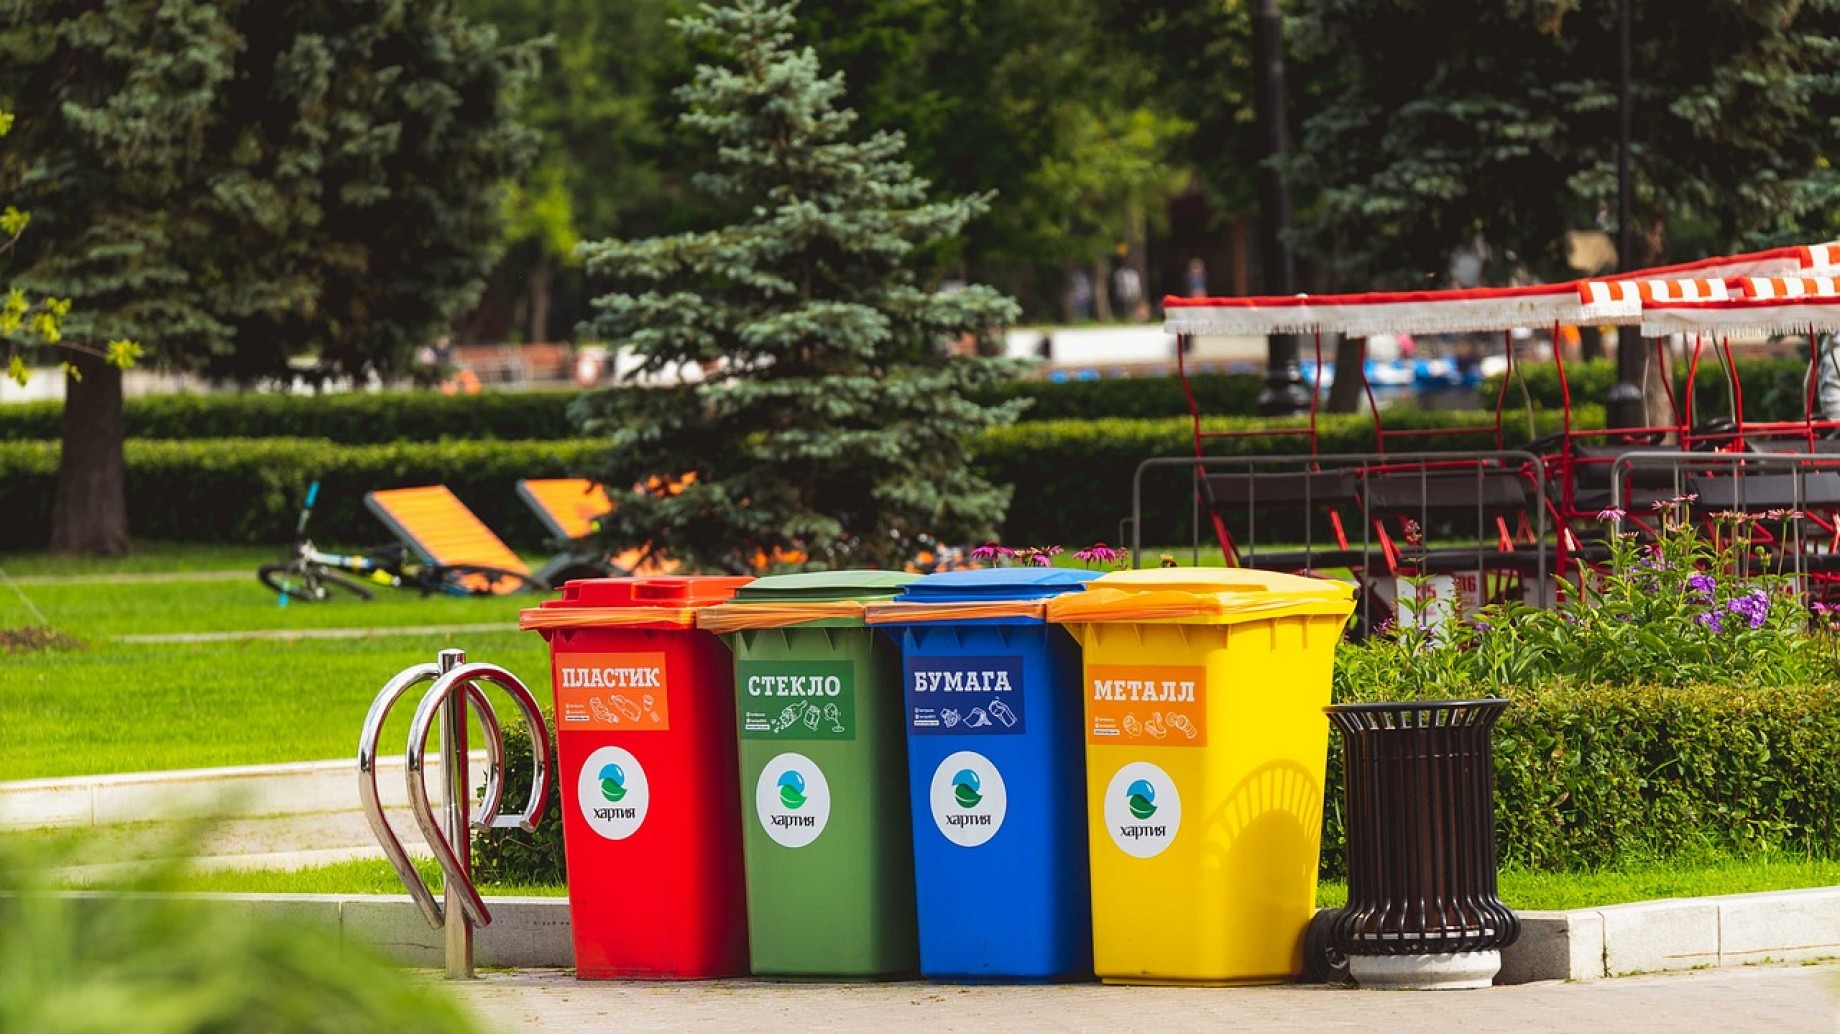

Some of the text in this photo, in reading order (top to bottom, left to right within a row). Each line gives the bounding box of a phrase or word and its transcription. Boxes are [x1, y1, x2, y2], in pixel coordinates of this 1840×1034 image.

[561, 667, 661, 688] ПЛАСТИК
[748, 675, 841, 696] СТЕКЛО
[914, 671, 1012, 692] БУМАГА
[1093, 679, 1196, 702] МЕТАЛЛ
[593, 807, 636, 822] хартия
[770, 814, 816, 829] хартия
[945, 814, 991, 829] хартия
[1120, 825, 1167, 840] хартия
